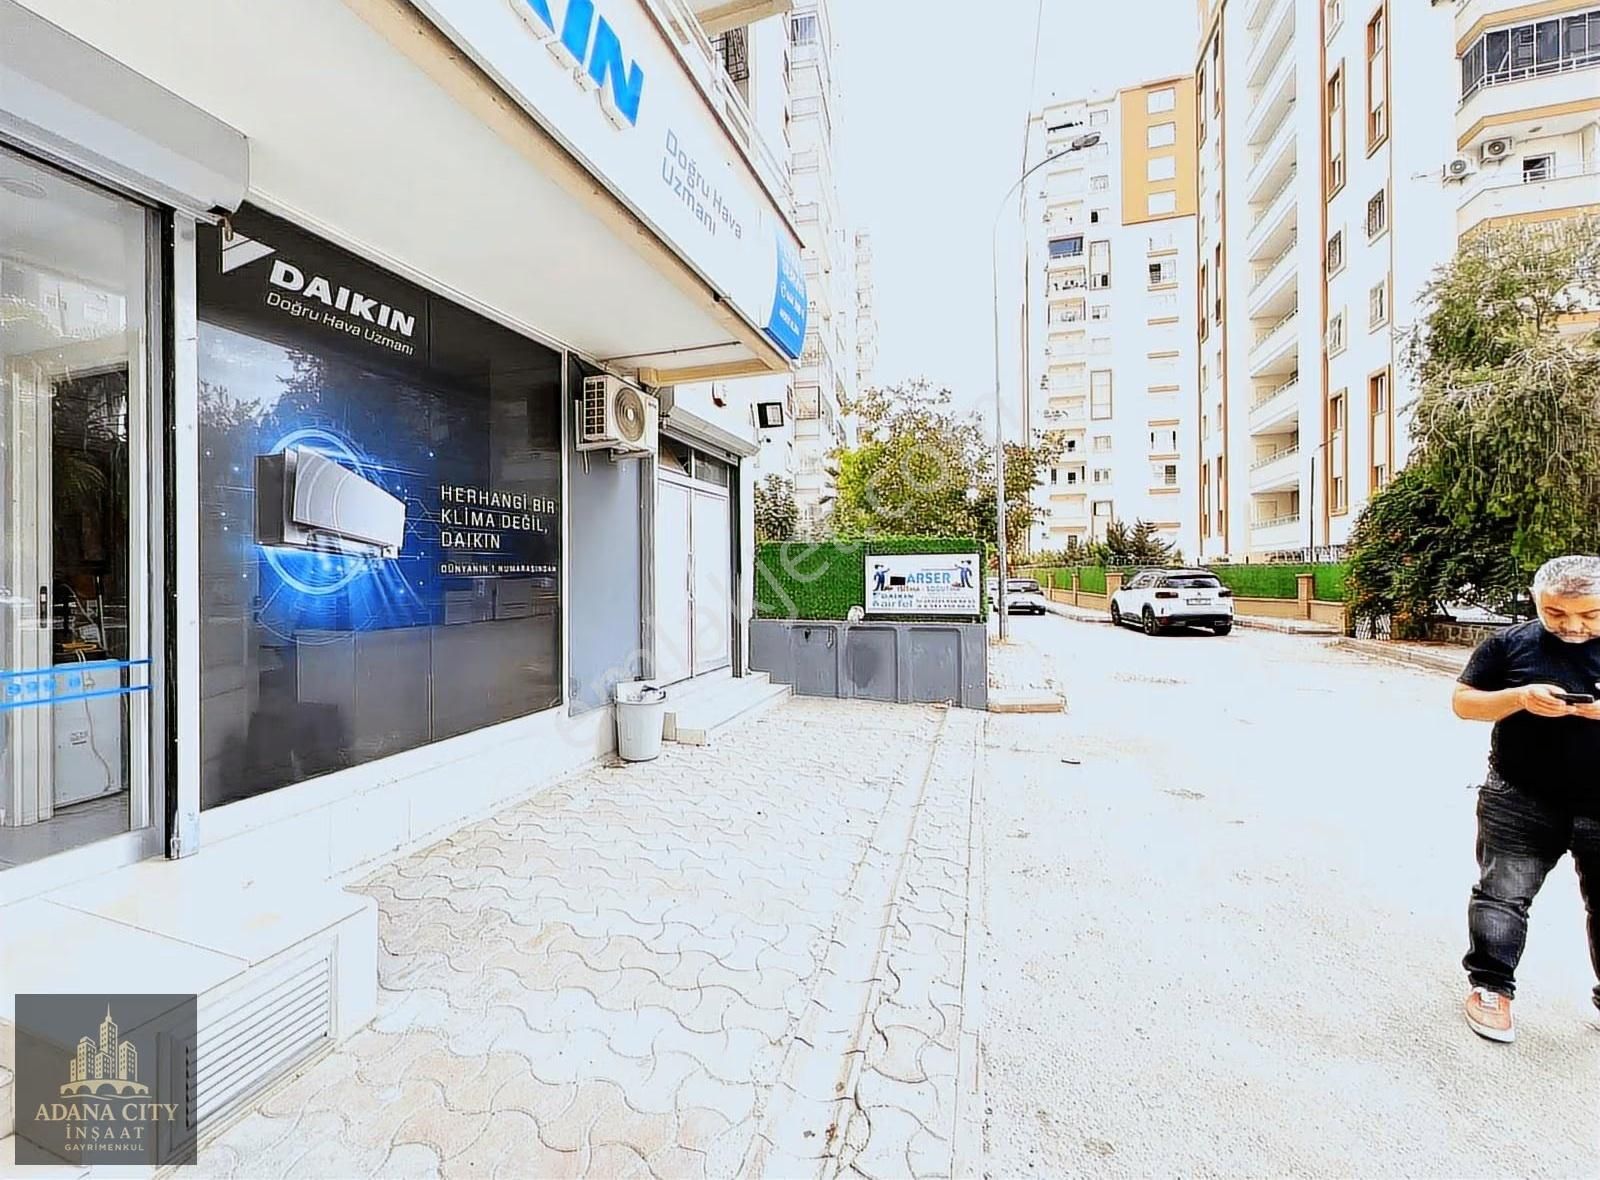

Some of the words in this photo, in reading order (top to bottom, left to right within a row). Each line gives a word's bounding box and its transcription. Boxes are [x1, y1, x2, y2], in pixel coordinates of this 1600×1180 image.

[662, 156, 716, 236] Uzmanı
[666, 128, 710, 198] Doğru
[713, 189, 742, 239] Hava
[269, 259, 415, 337] DAIKIN
[267, 292, 320, 321] Doğru
[323, 312, 361, 337] Hava
[364, 327, 414, 356] Uzmanı
[441, 484, 527, 511] HERHANGİ
[533, 497, 555, 514] BİR
[441, 506, 495, 527] KLİMA
[502, 514, 548, 535] DEĞİL,
[441, 531, 500, 549] DAIKIN
[907, 572, 951, 584] ARSER
